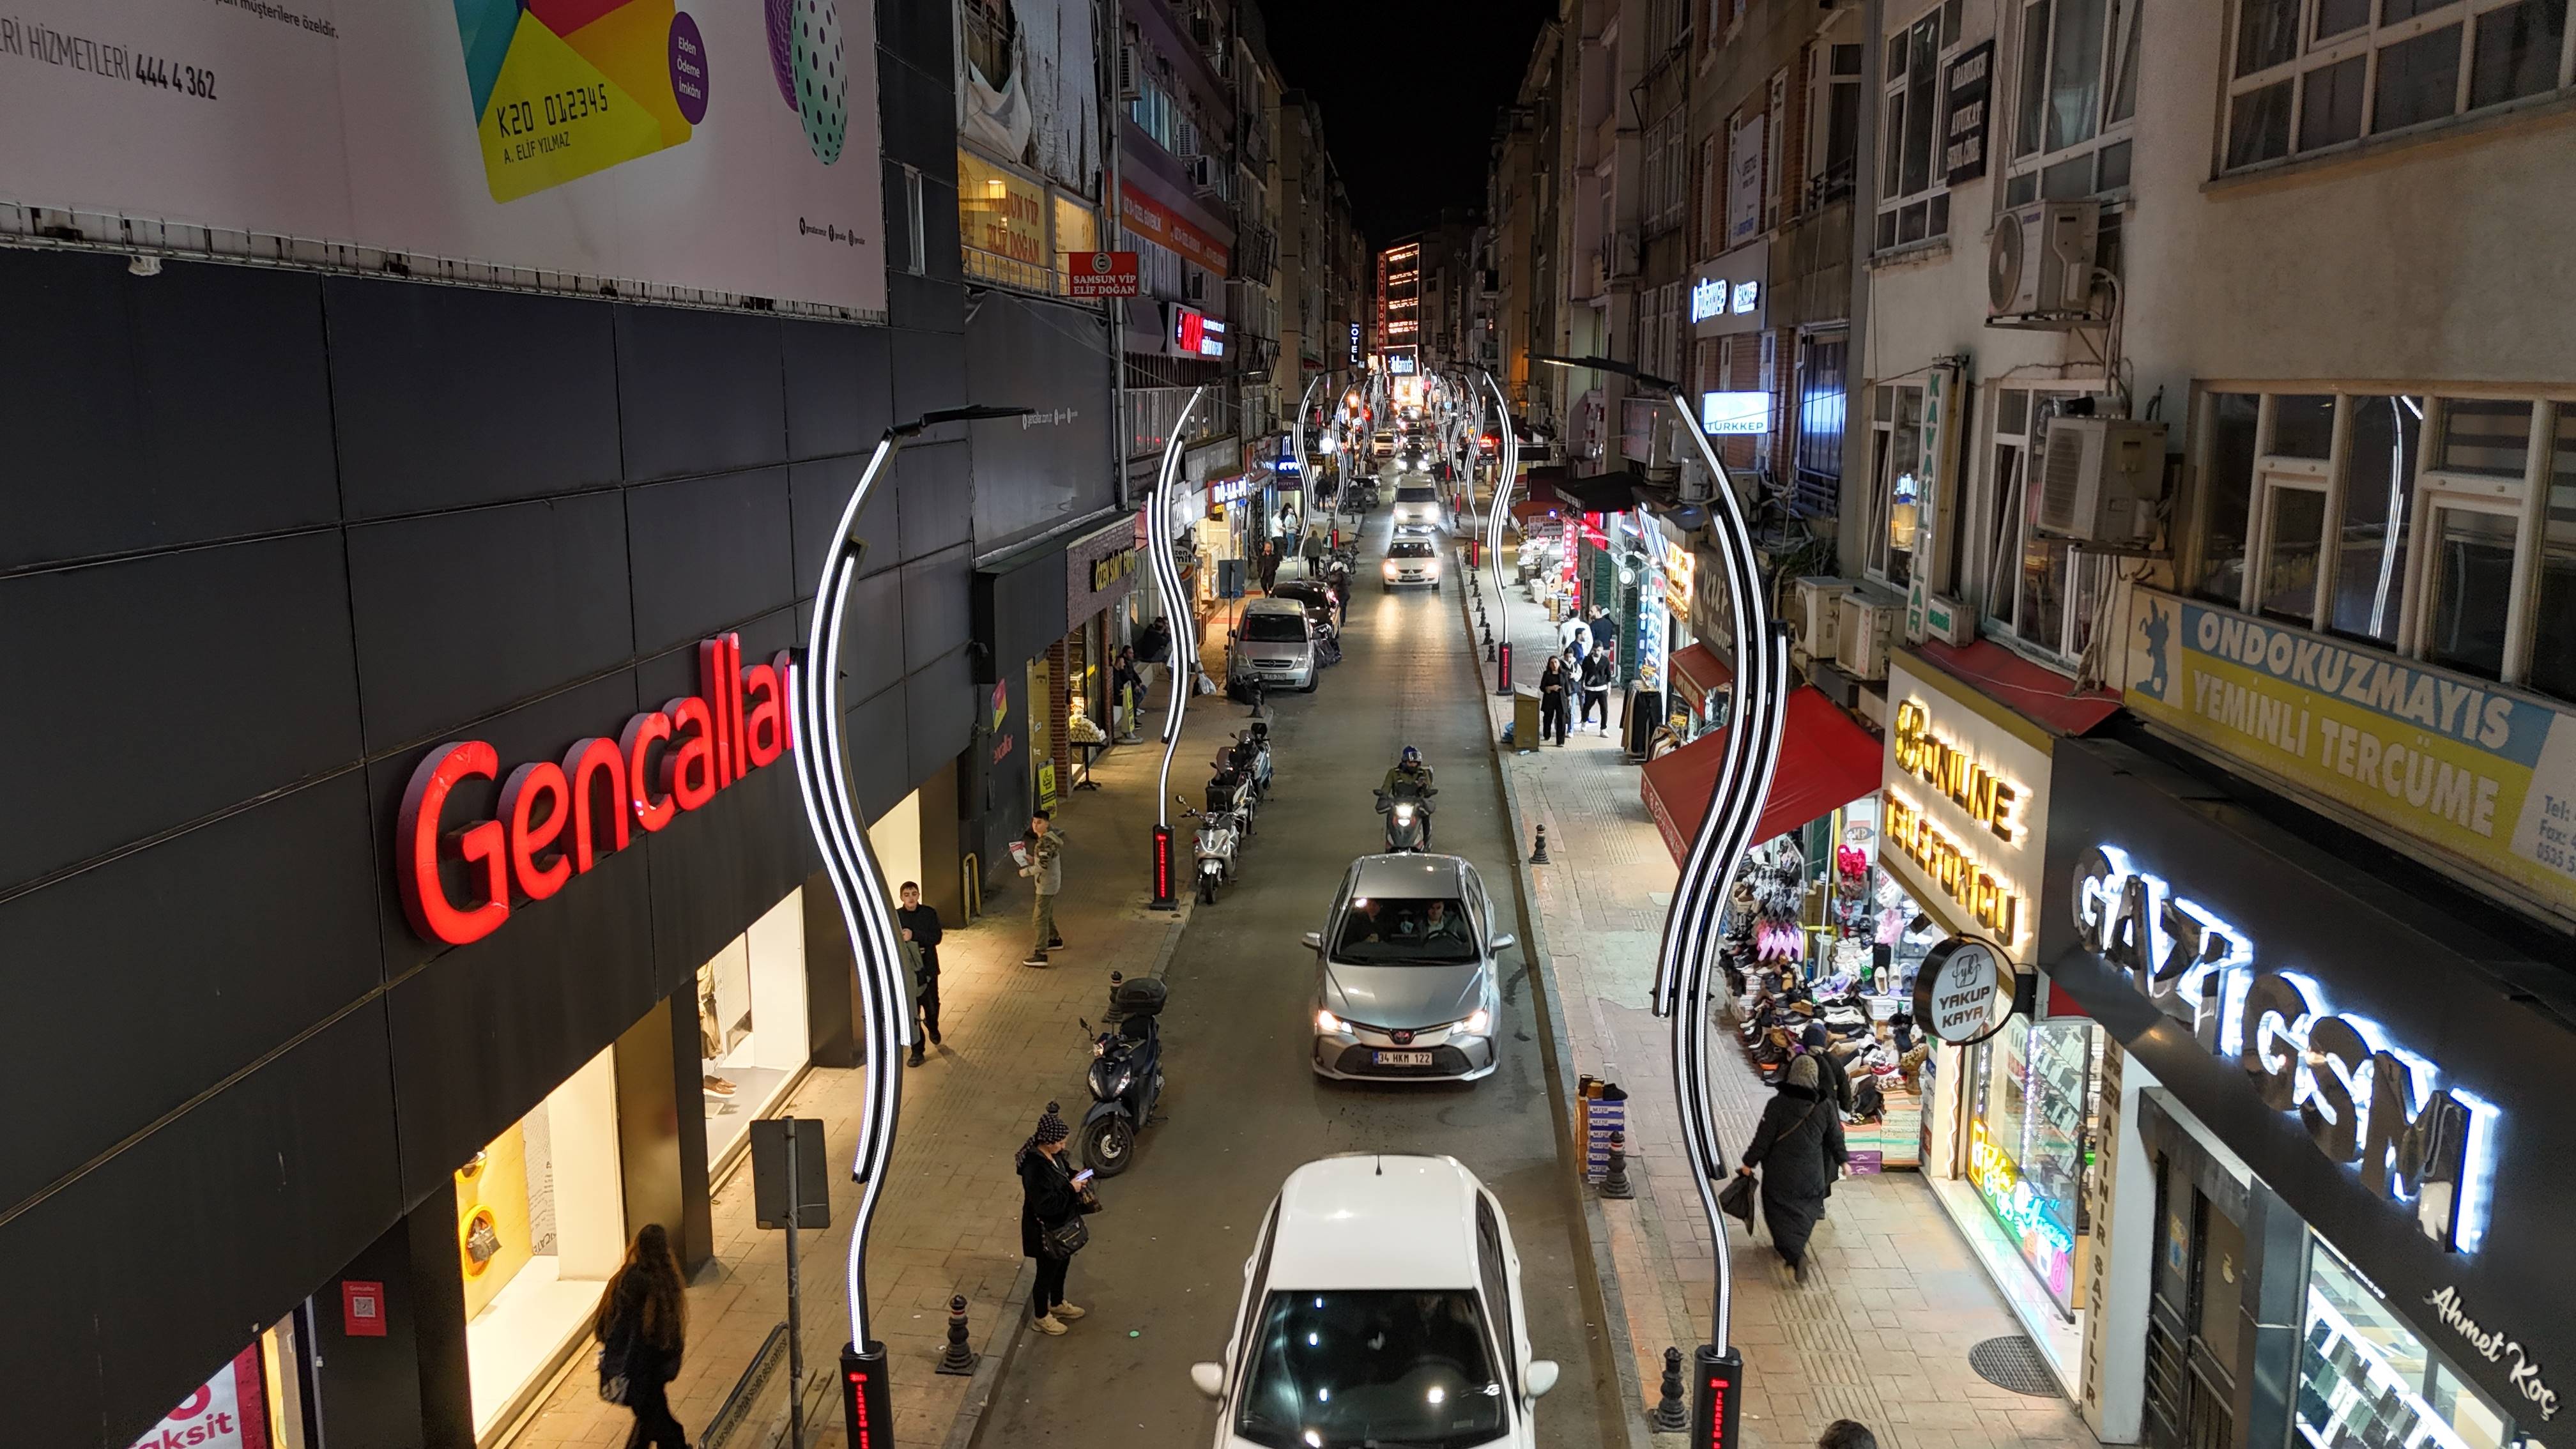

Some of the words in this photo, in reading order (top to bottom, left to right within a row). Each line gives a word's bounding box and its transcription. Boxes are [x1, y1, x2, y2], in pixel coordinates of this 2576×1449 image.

[302, 15, 339, 39] özeldir.
[0, 16, 23, 56] Rİ
[27, 23, 131, 81] HİZMETLERİ
[135, 54, 169, 89] 444
[172, 63, 183, 93] 4
[186, 66, 217, 100] 362
[677, 36, 697, 56] Elden
[677, 55, 701, 79] Ödeme
[496, 100, 535, 138] K20
[544, 83, 608, 126] 012345
[503, 148, 514, 164] A.
[516, 139, 536, 160] ELİF
[537, 131, 571, 155] YILMAZ
[1073, 275, 1116, 284] SAMSUN
[1119, 272, 1137, 284] VİP
[1073, 284, 1096, 295] ELİF
[1098, 283, 1135, 295] DOĞAN
[2198, 611, 2513, 750] ONDOKUZMAYIS
[2193, 670, 2310, 758] YEMİNLİ
[2320, 716, 2500, 838] TERCÜME
[2545, 794, 2570, 822] Tel:
[1882, 788, 2017, 947] TELEFONCU
[1938, 986, 1990, 1010] YAKUP
[1942, 1006, 1984, 1029] KAYA
[1379, 1054, 1390, 1062] 34
[1393, 1054, 1409, 1063] HKM
[1414, 1055, 1430, 1064] 122
[2243, 971, 2482, 1254] GSM
[2096, 1115, 2114, 1248] ALINIR
[2085, 1255, 2104, 1409] SATILIR
[2422, 1285, 2505, 1363] Ahmet
[2506, 1341, 2560, 1422] Koç
[128, 1412, 234, 1449] ksit
